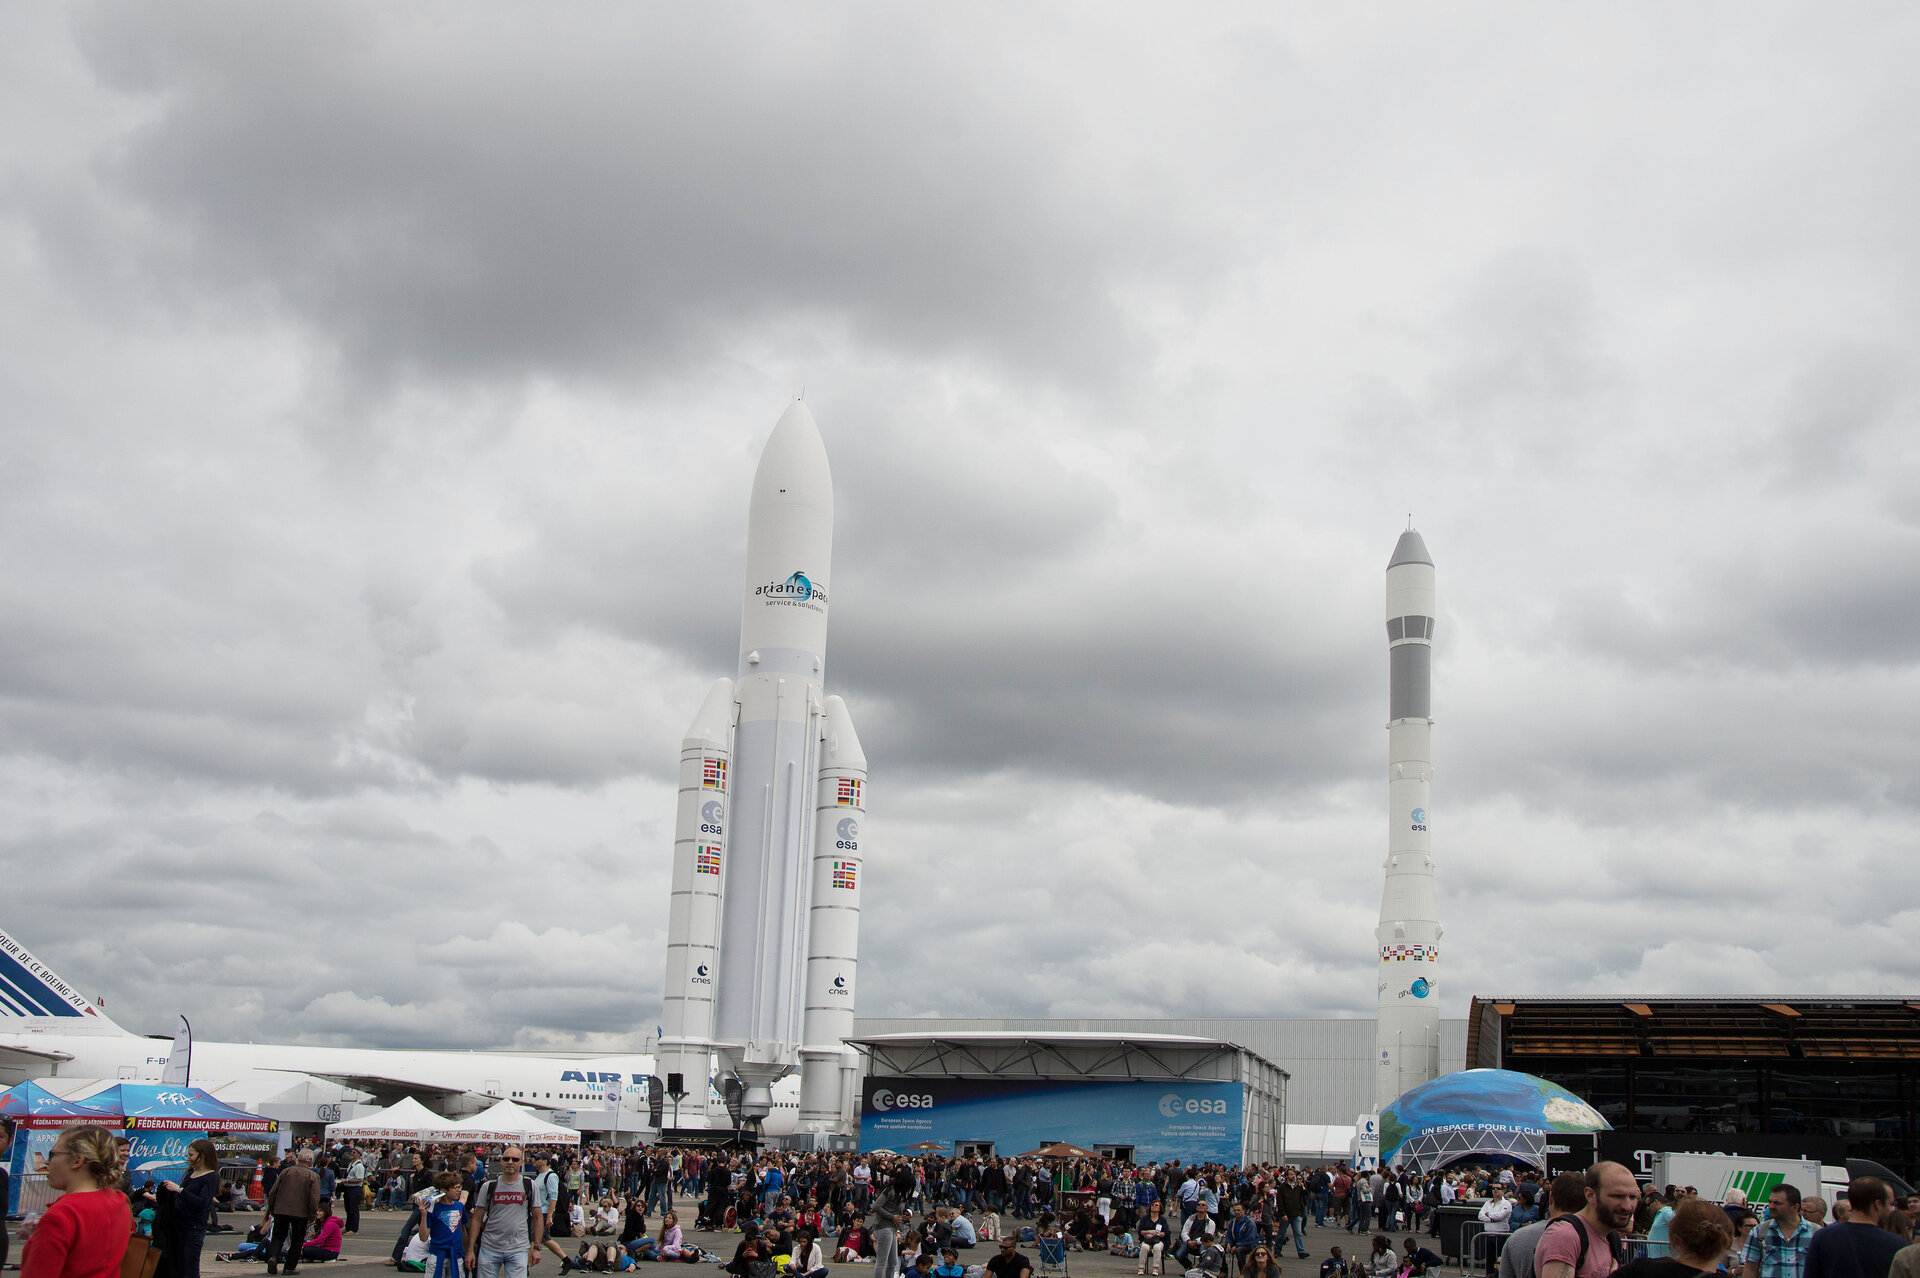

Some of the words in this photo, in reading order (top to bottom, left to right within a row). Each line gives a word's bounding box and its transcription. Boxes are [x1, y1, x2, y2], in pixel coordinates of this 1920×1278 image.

[798, 602, 824, 614] solutions
[700, 823, 722, 835] esa
[836, 840, 858, 850] esa
[0, 932, 19, 955] OEUR
[18, 952, 32, 965] DE
[30, 962, 42, 973] CE
[40, 970, 70, 996] BOEING
[69, 993, 86, 1007] 747
[691, 977, 711, 985] cnes
[829, 988, 849, 996] cnes
[561, 1071, 622, 1083] AIR
[156, 1092, 193, 1106] FFA
[896, 1093, 934, 1108] esa
[1185, 1099, 1227, 1114] esa
[137, 1117, 181, 1129] FÉDÉRATION
[183, 1119, 219, 1131] FRANÇAISE
[221, 1119, 269, 1131] AÉRONAUTIQUE
[1421, 1127, 1435, 1136] UN
[1436, 1123, 1474, 1133] ESPACE
[1478, 1123, 1507, 1132] POUR
[355, 1129, 378, 1137] Amour
[381, 1129, 390, 1137] de
[494, 1132, 520, 1140] Bonbon
[1360, 1133, 1379, 1141] cnes
